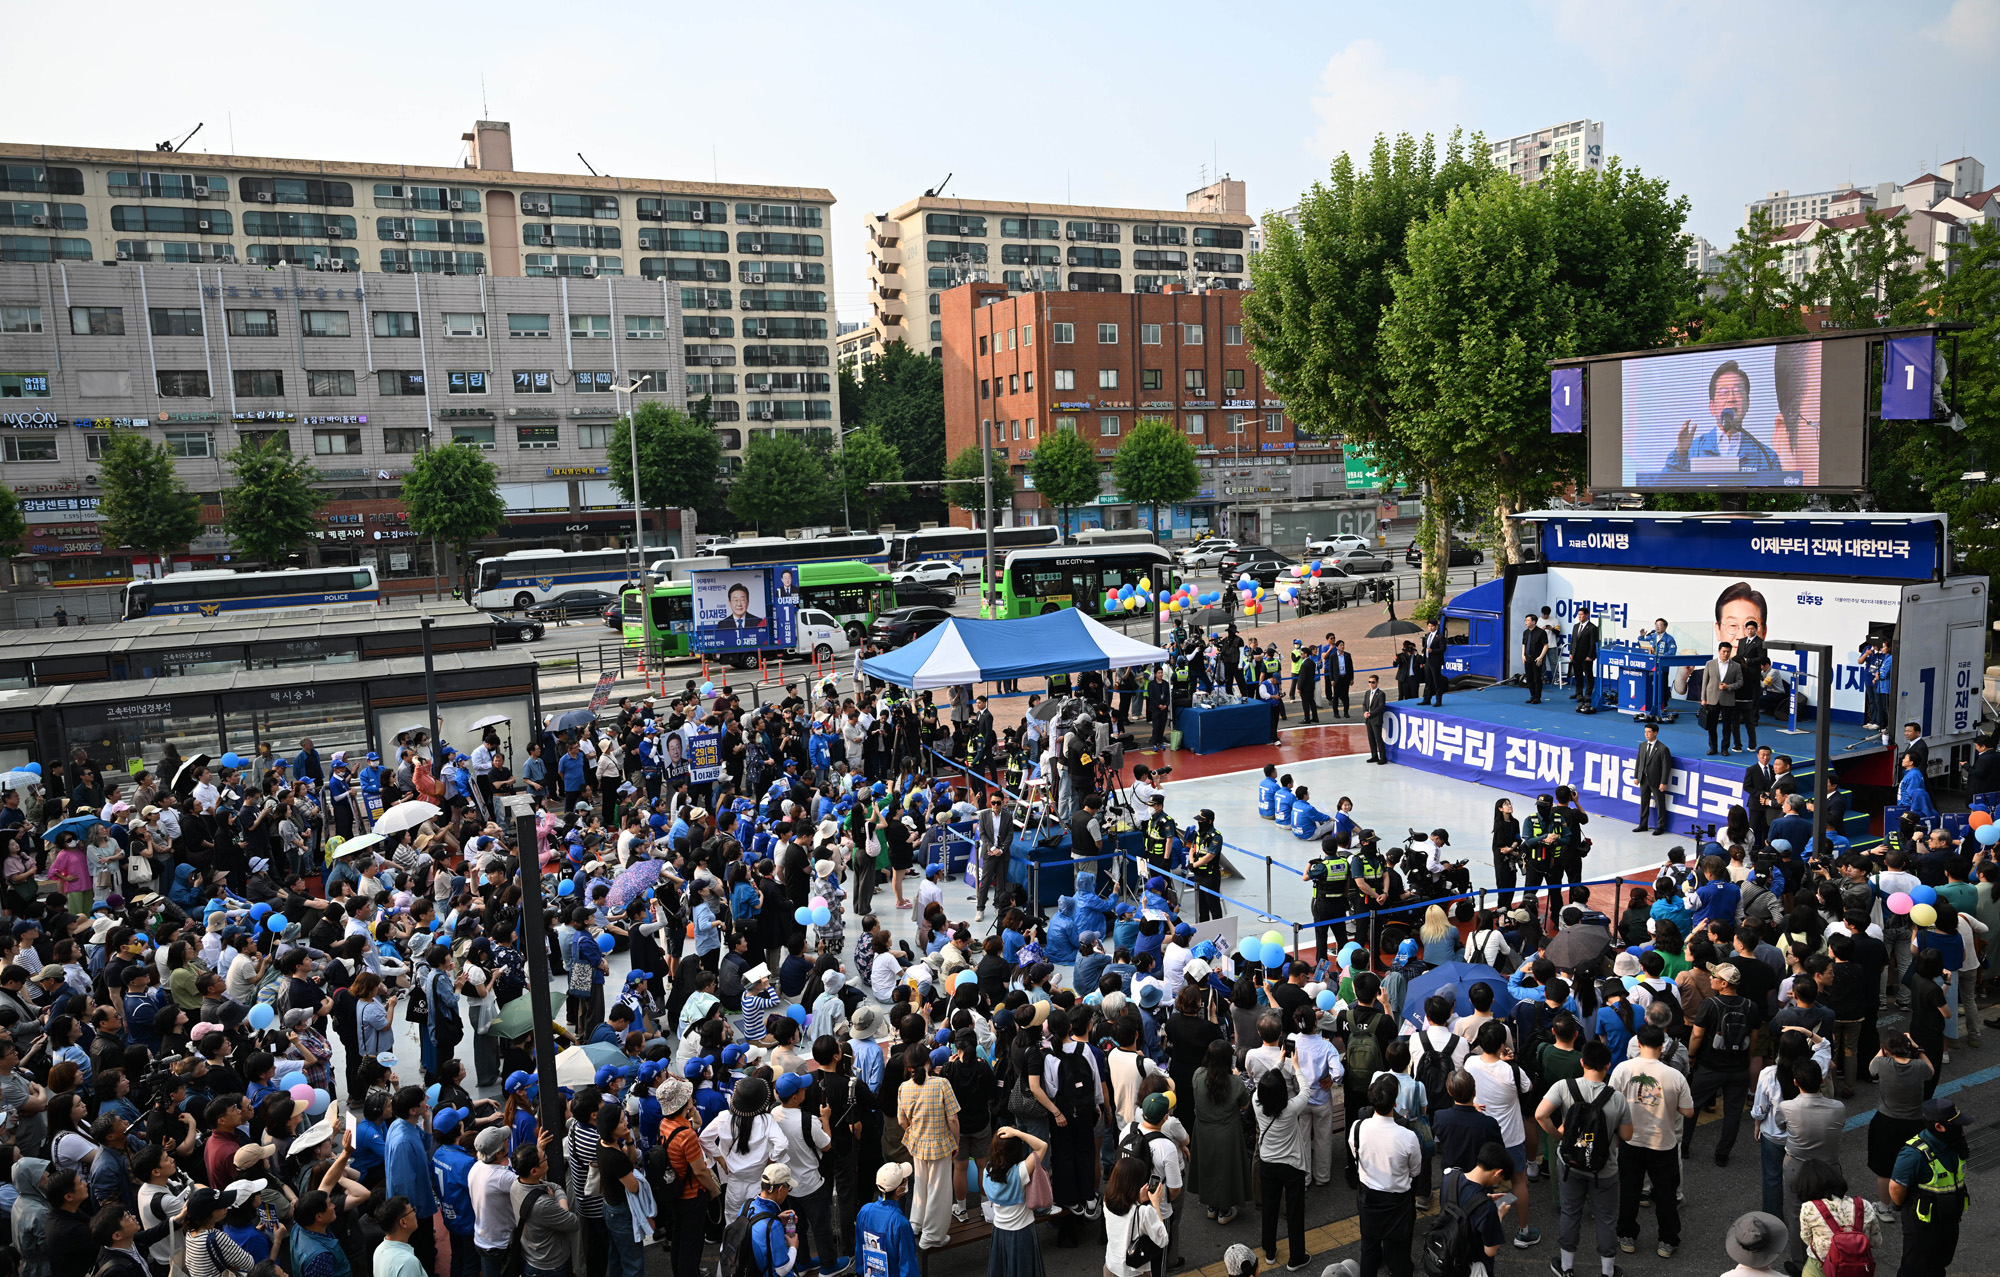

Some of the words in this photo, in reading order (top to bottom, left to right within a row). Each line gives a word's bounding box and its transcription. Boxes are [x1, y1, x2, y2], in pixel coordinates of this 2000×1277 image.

[409, 375, 423, 383] THE
[451, 373, 483, 386] 드림
[516, 373, 548, 386] 가발
[595, 372, 611, 384] 4030
[1905, 365, 1915, 390] 1
[1563, 385, 1571, 406] 1
[24, 499, 78, 511] 강남센트럴
[1337, 509, 1376, 539] G12
[1554, 524, 1563, 548] 1
[1569, 540, 1588, 549] 지금은
[1587, 532, 1630, 550] 이재명
[1751, 536, 1808, 556] 이제부터
[1811, 537, 1842, 556] 진짜
[1845, 538, 1911, 559] 대한민국
[324, 593, 349, 602] POLICE
[698, 597, 704, 610] 1
[777, 596, 800, 605] 이재명
[1796, 595, 1824, 606] 민주당
[173, 604, 190, 613] 경찰
[699, 608, 728, 620] 이재명
[783, 606, 790, 622] 1
[1556, 599, 1628, 629] 이제부터
[162, 650, 213, 662] 고속터미널경부선
[1608, 657, 1625, 666] 지금은
[1624, 655, 1629, 667] 1
[1629, 660, 1646, 669] 이재명
[1957, 660, 1972, 669] 지금은
[270, 690, 316, 701] 택시승차
[1628, 679, 1636, 699] 1
[1919, 666, 1936, 738] 1
[1954, 669, 1971, 730] 이재명
[106, 702, 172, 717] 고속터미널경부선
[692, 738, 718, 748] 사전투표
[1381, 711, 1495, 772] 이제부터
[1504, 735, 1575, 787] 진짜
[693, 770, 698, 781] 1
[697, 769, 720, 780] 이재명
[1276, 796, 1282, 813] 1
[1293, 811, 1299, 827] 1
[434, 1166, 445, 1197] 1
